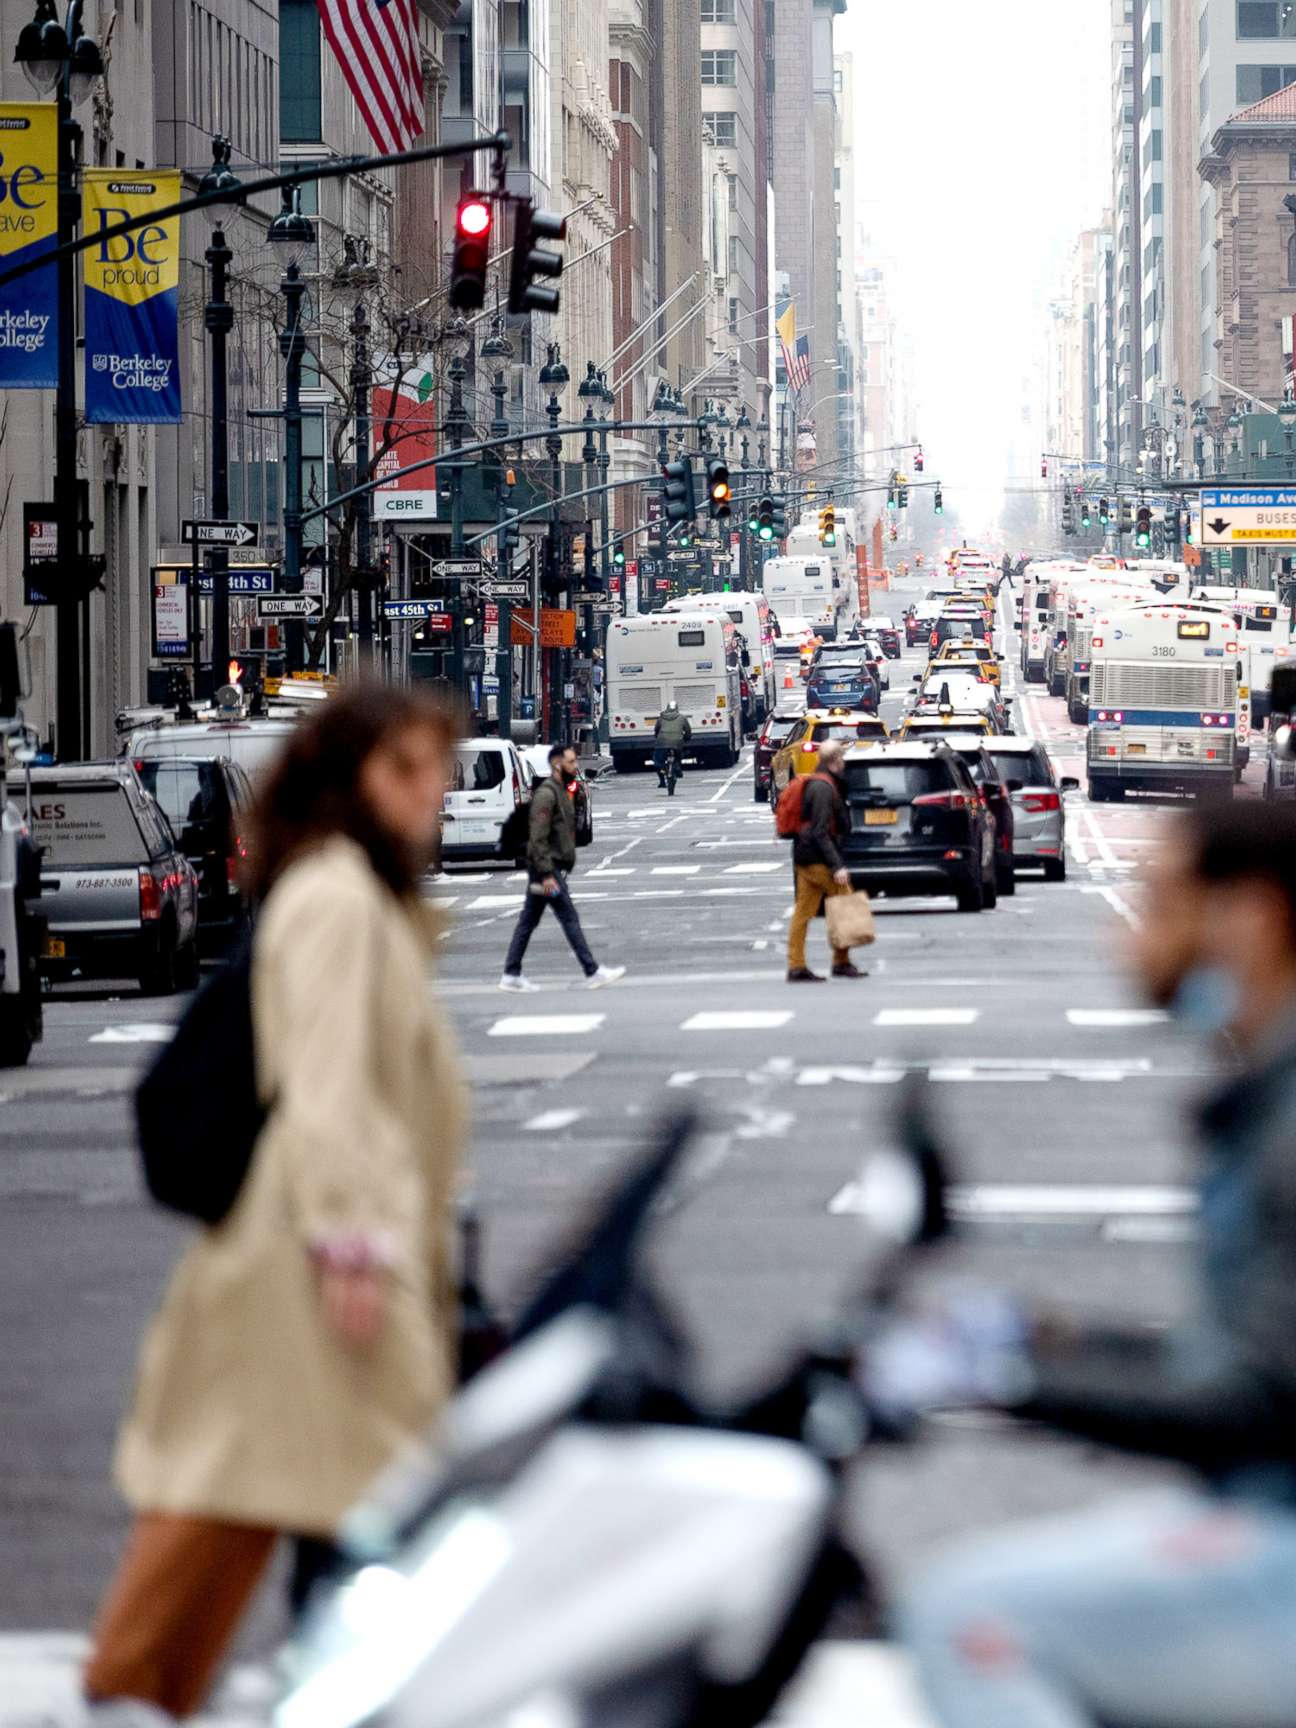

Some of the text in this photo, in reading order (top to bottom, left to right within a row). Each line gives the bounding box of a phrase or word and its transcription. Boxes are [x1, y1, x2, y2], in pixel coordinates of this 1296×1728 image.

[0, 153, 46, 209] e
[92, 207, 169, 265] Be
[103, 266, 160, 288] proud
[109, 353, 173, 375] Berkeley
[112, 370, 169, 392] College
[378, 479, 399, 489] ORLD
[1220, 493, 1273, 504] Madison
[386, 500, 423, 510] CBRE
[32, 523, 40, 537] 3
[200, 528, 247, 539] NE WAY
[233, 550, 256, 563] 350
[435, 563, 478, 573] ONE WAY
[228, 575, 249, 589] 4th
[252, 575, 267, 589] St
[158, 586, 164, 598] 3
[484, 584, 523, 593] ONE WAY
[267, 601, 313, 611] ONE WAY
[384, 602, 439, 616] ast 45th St
[1152, 646, 1176, 657] 3180
[23, 804, 66, 820] AES
[55, 821, 88, 829] Solutions
